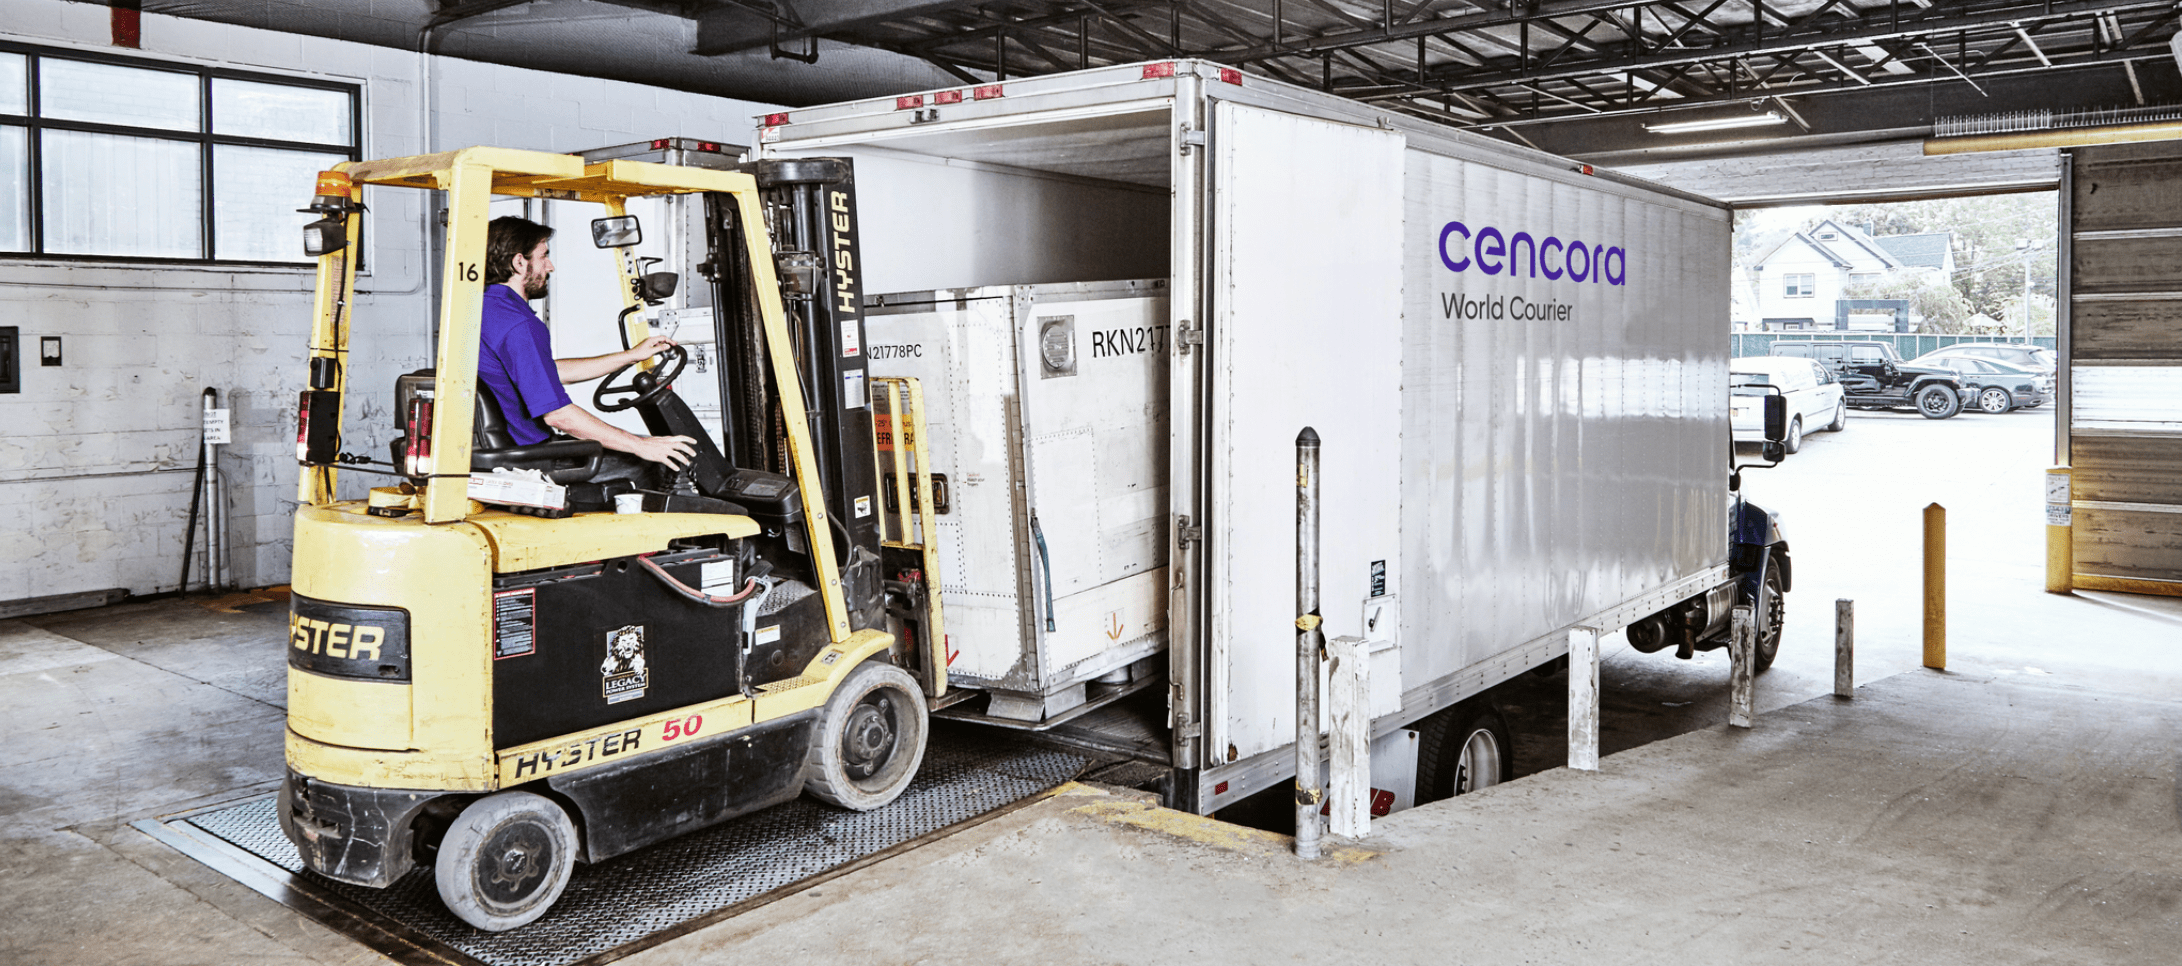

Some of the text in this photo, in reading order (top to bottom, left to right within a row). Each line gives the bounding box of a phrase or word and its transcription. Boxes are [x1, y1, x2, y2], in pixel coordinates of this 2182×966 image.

[458, 261, 479, 282] 16
[830, 190, 856, 313] HYSTER
[1438, 221, 1626, 286] cencora
[1441, 292, 1573, 321] World Courier
[605, 673, 647, 690] LEGACY
[514, 713, 703, 778] HYSTER 50
